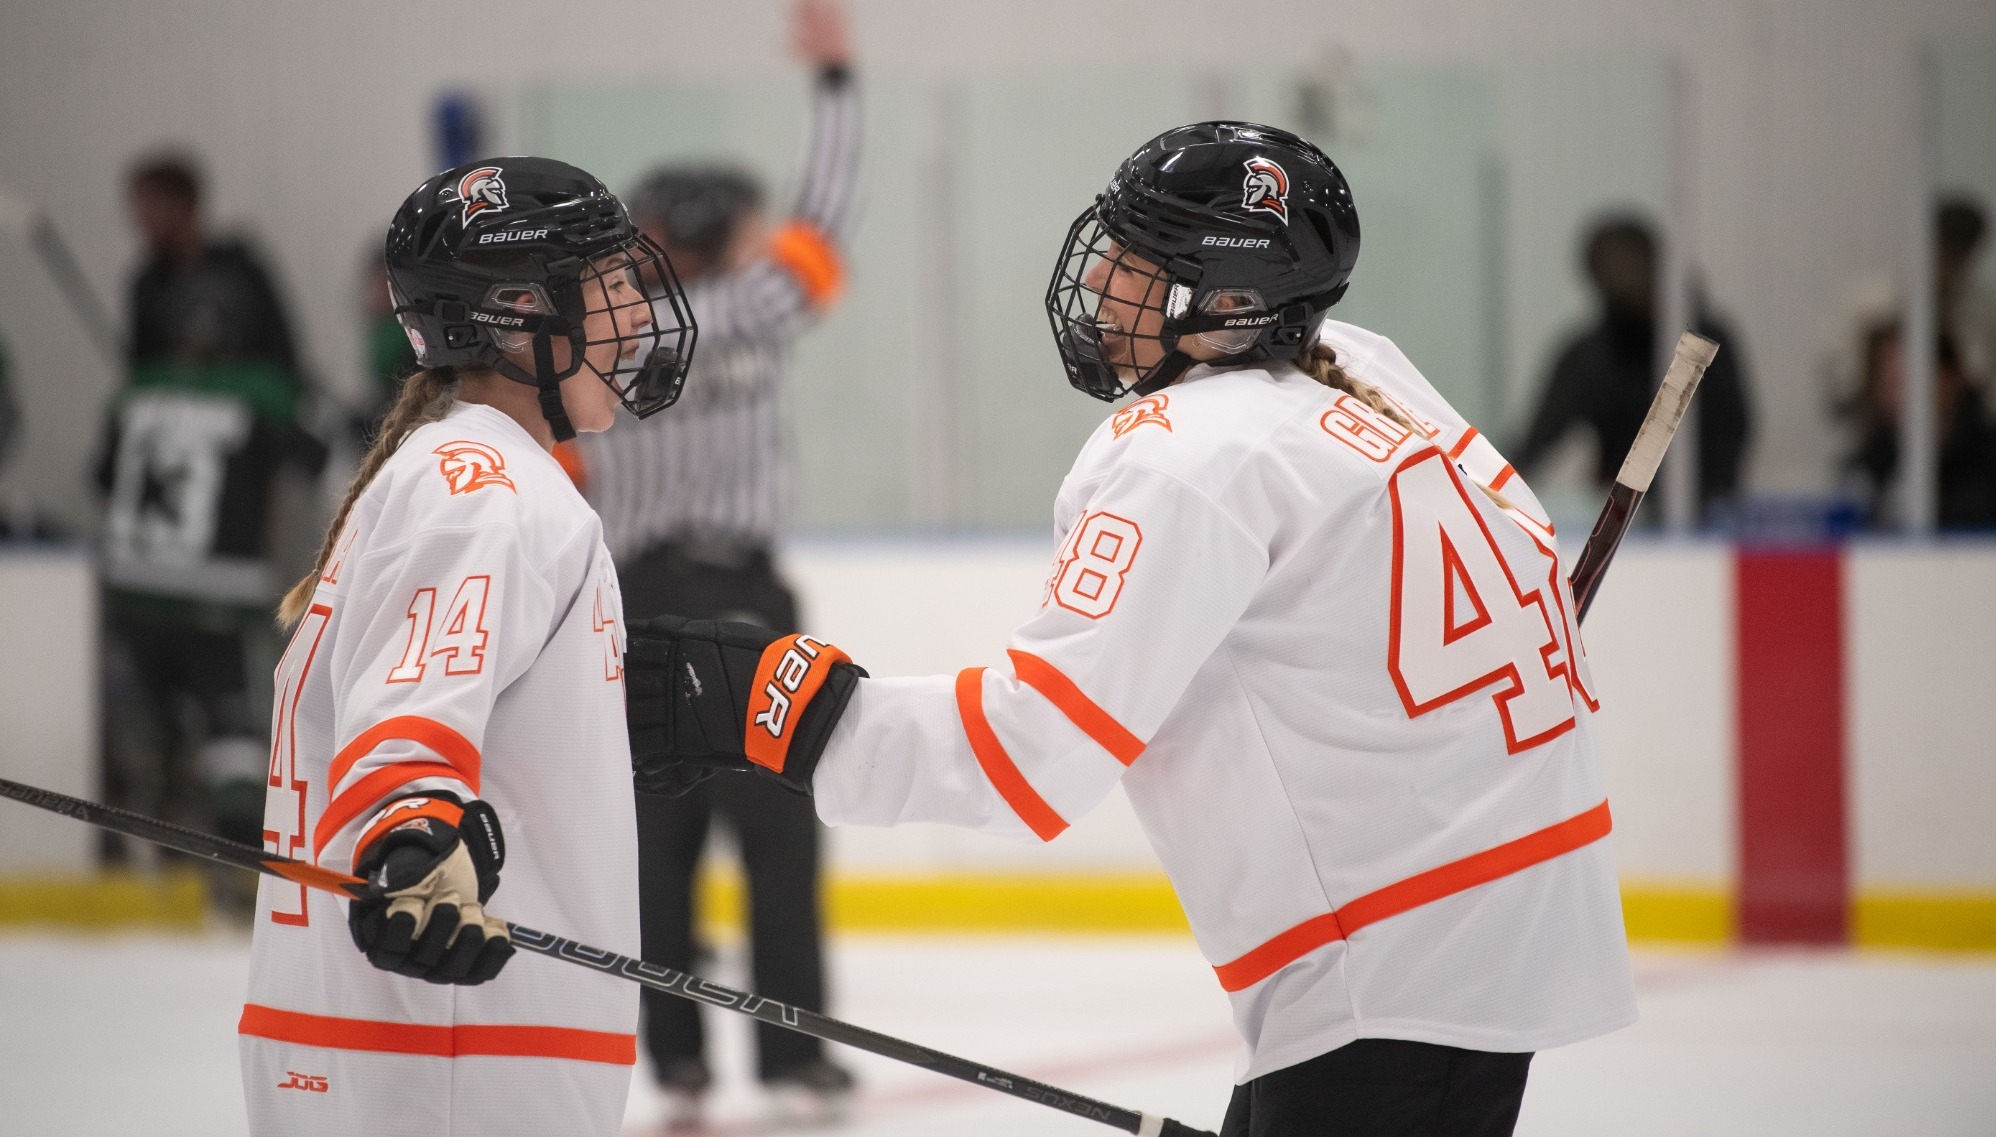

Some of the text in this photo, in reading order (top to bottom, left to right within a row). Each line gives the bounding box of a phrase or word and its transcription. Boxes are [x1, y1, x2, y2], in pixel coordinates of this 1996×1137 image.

[478, 229, 548, 244] BAUER
[1202, 236, 1270, 249] BAUER
[1224, 313, 1279, 327] BAUER
[385, 574, 491, 685] 14
[479, 813, 500, 861] BAUER
